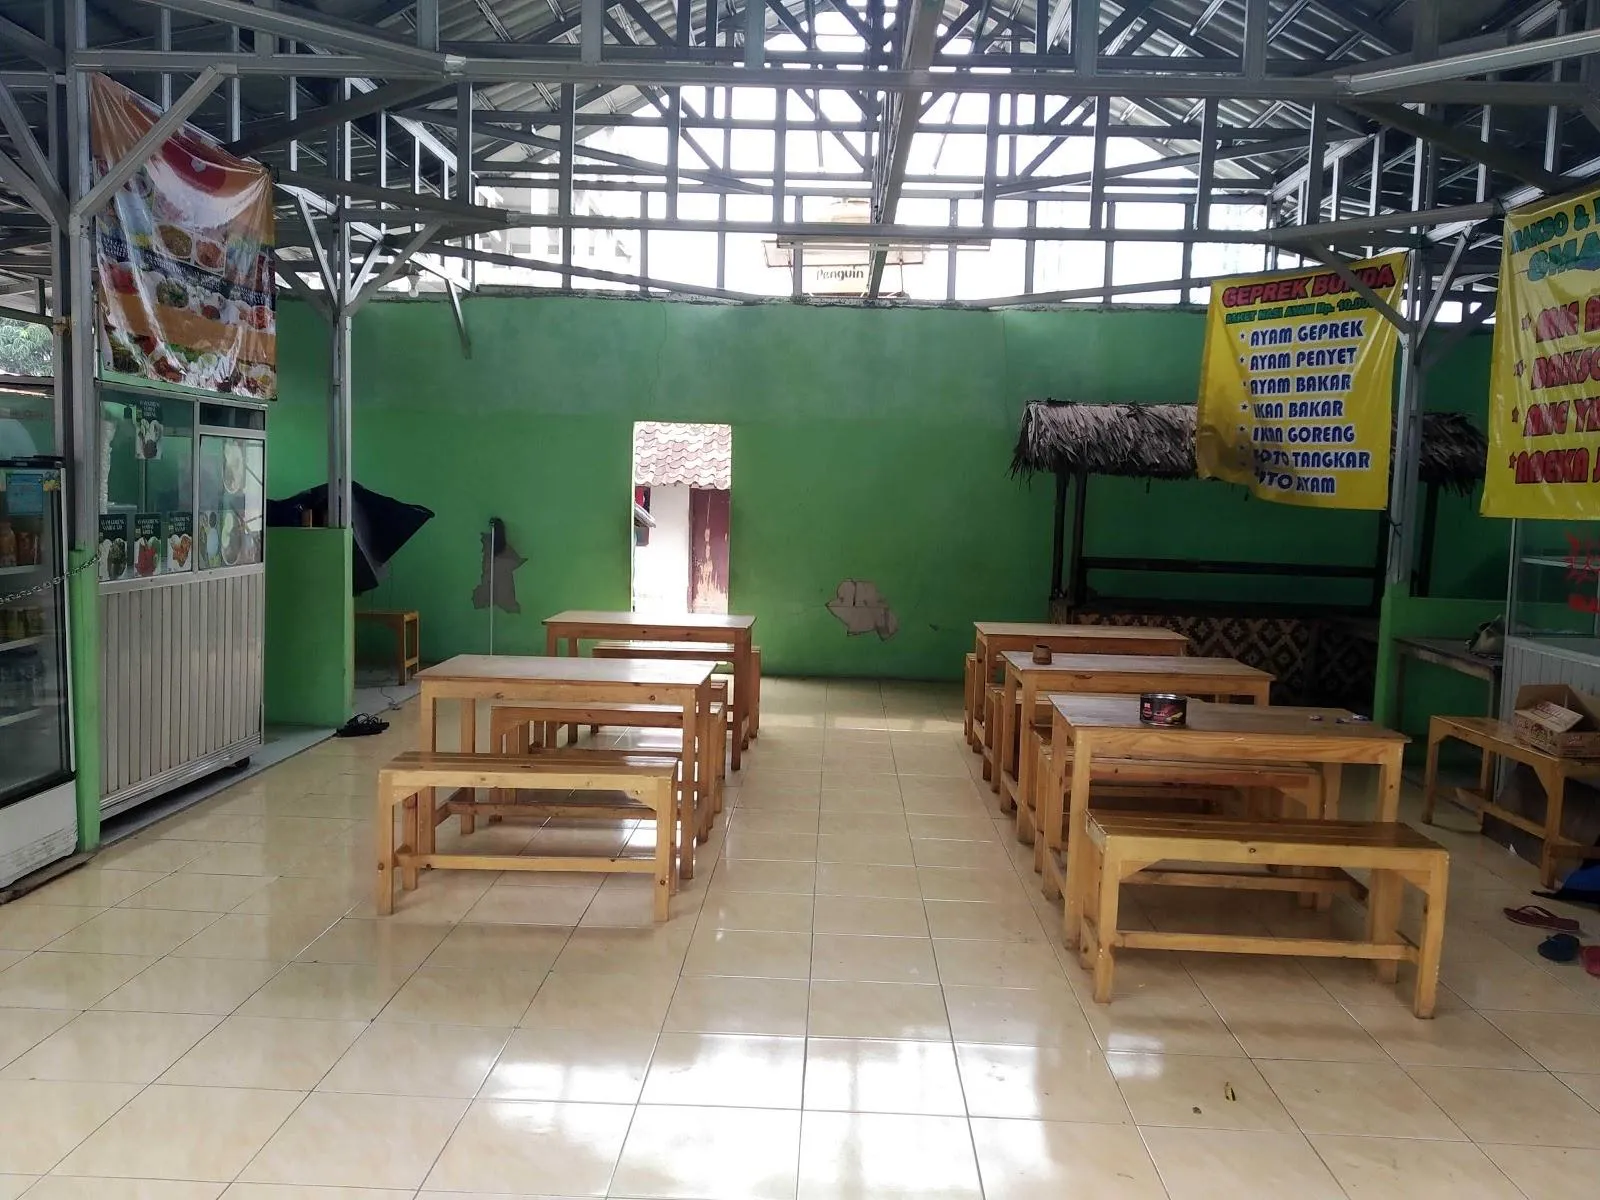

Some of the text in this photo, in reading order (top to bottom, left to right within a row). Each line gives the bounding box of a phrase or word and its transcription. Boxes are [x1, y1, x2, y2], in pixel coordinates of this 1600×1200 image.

[816, 267, 864, 281] Penguin
[1222, 277, 1313, 308] GEPREK
[1250, 320, 1364, 347] AYAM GEPREK
[1250, 347, 1357, 371] AYAM PENYET
[1250, 374, 1351, 395] AYAM BAKAR
[1254, 400, 1344, 419] IKAN BAKAR
[1253, 425, 1355, 443] IKAN GORENG
[1292, 451, 1370, 469] TANGKAR
[1296, 475, 1335, 494] AYAM
